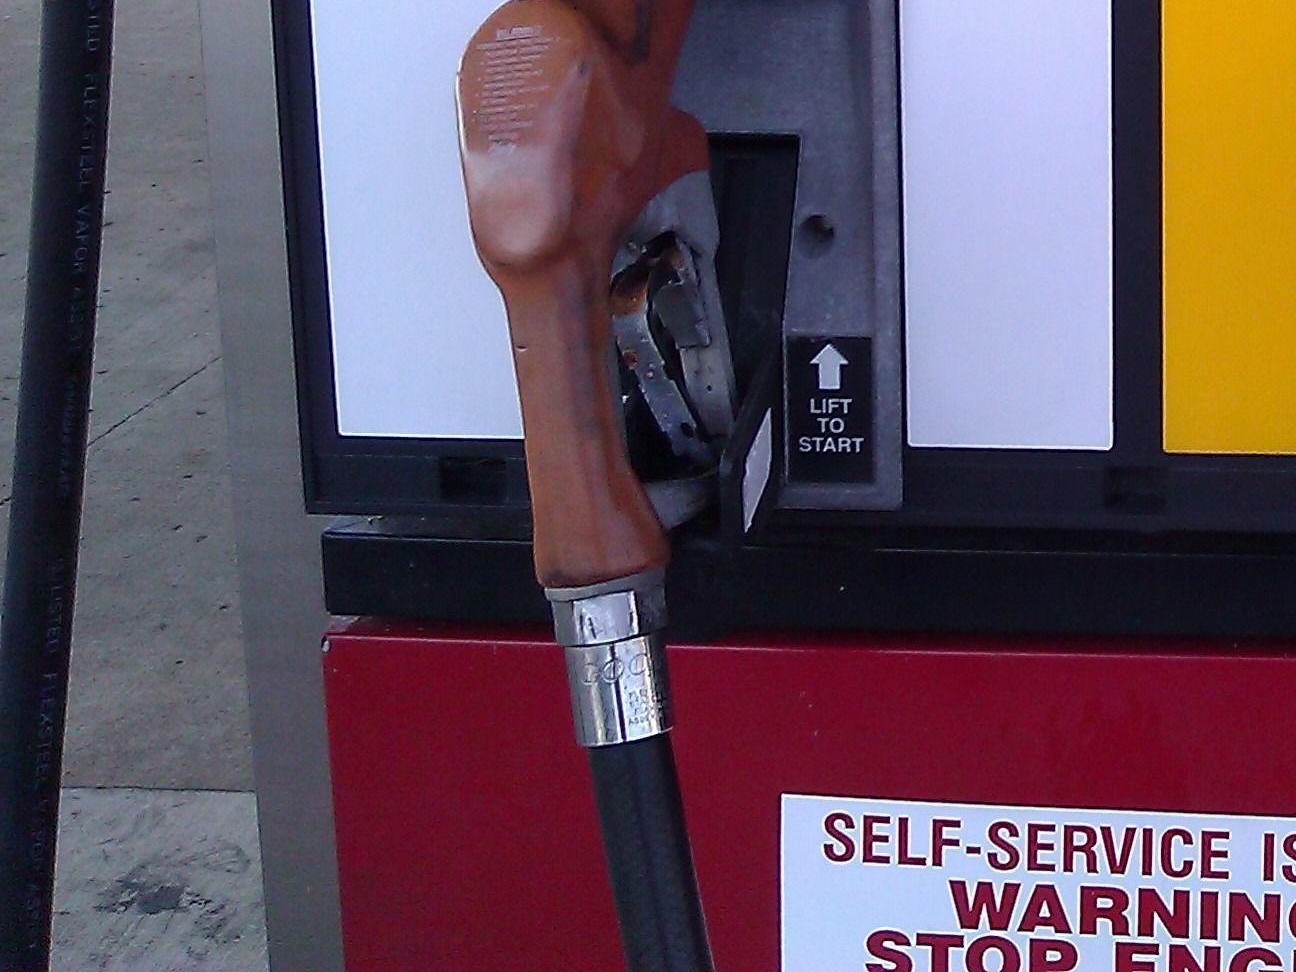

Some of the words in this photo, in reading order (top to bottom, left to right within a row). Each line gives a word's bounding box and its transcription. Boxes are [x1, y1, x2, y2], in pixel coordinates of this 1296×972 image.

[811, 399, 852, 413] LIFT
[817, 418, 844, 433] TO
[799, 437, 864, 452] START
[823, 812, 1230, 881] SELF-SERVICE
[865, 930, 1078, 972] STOP
